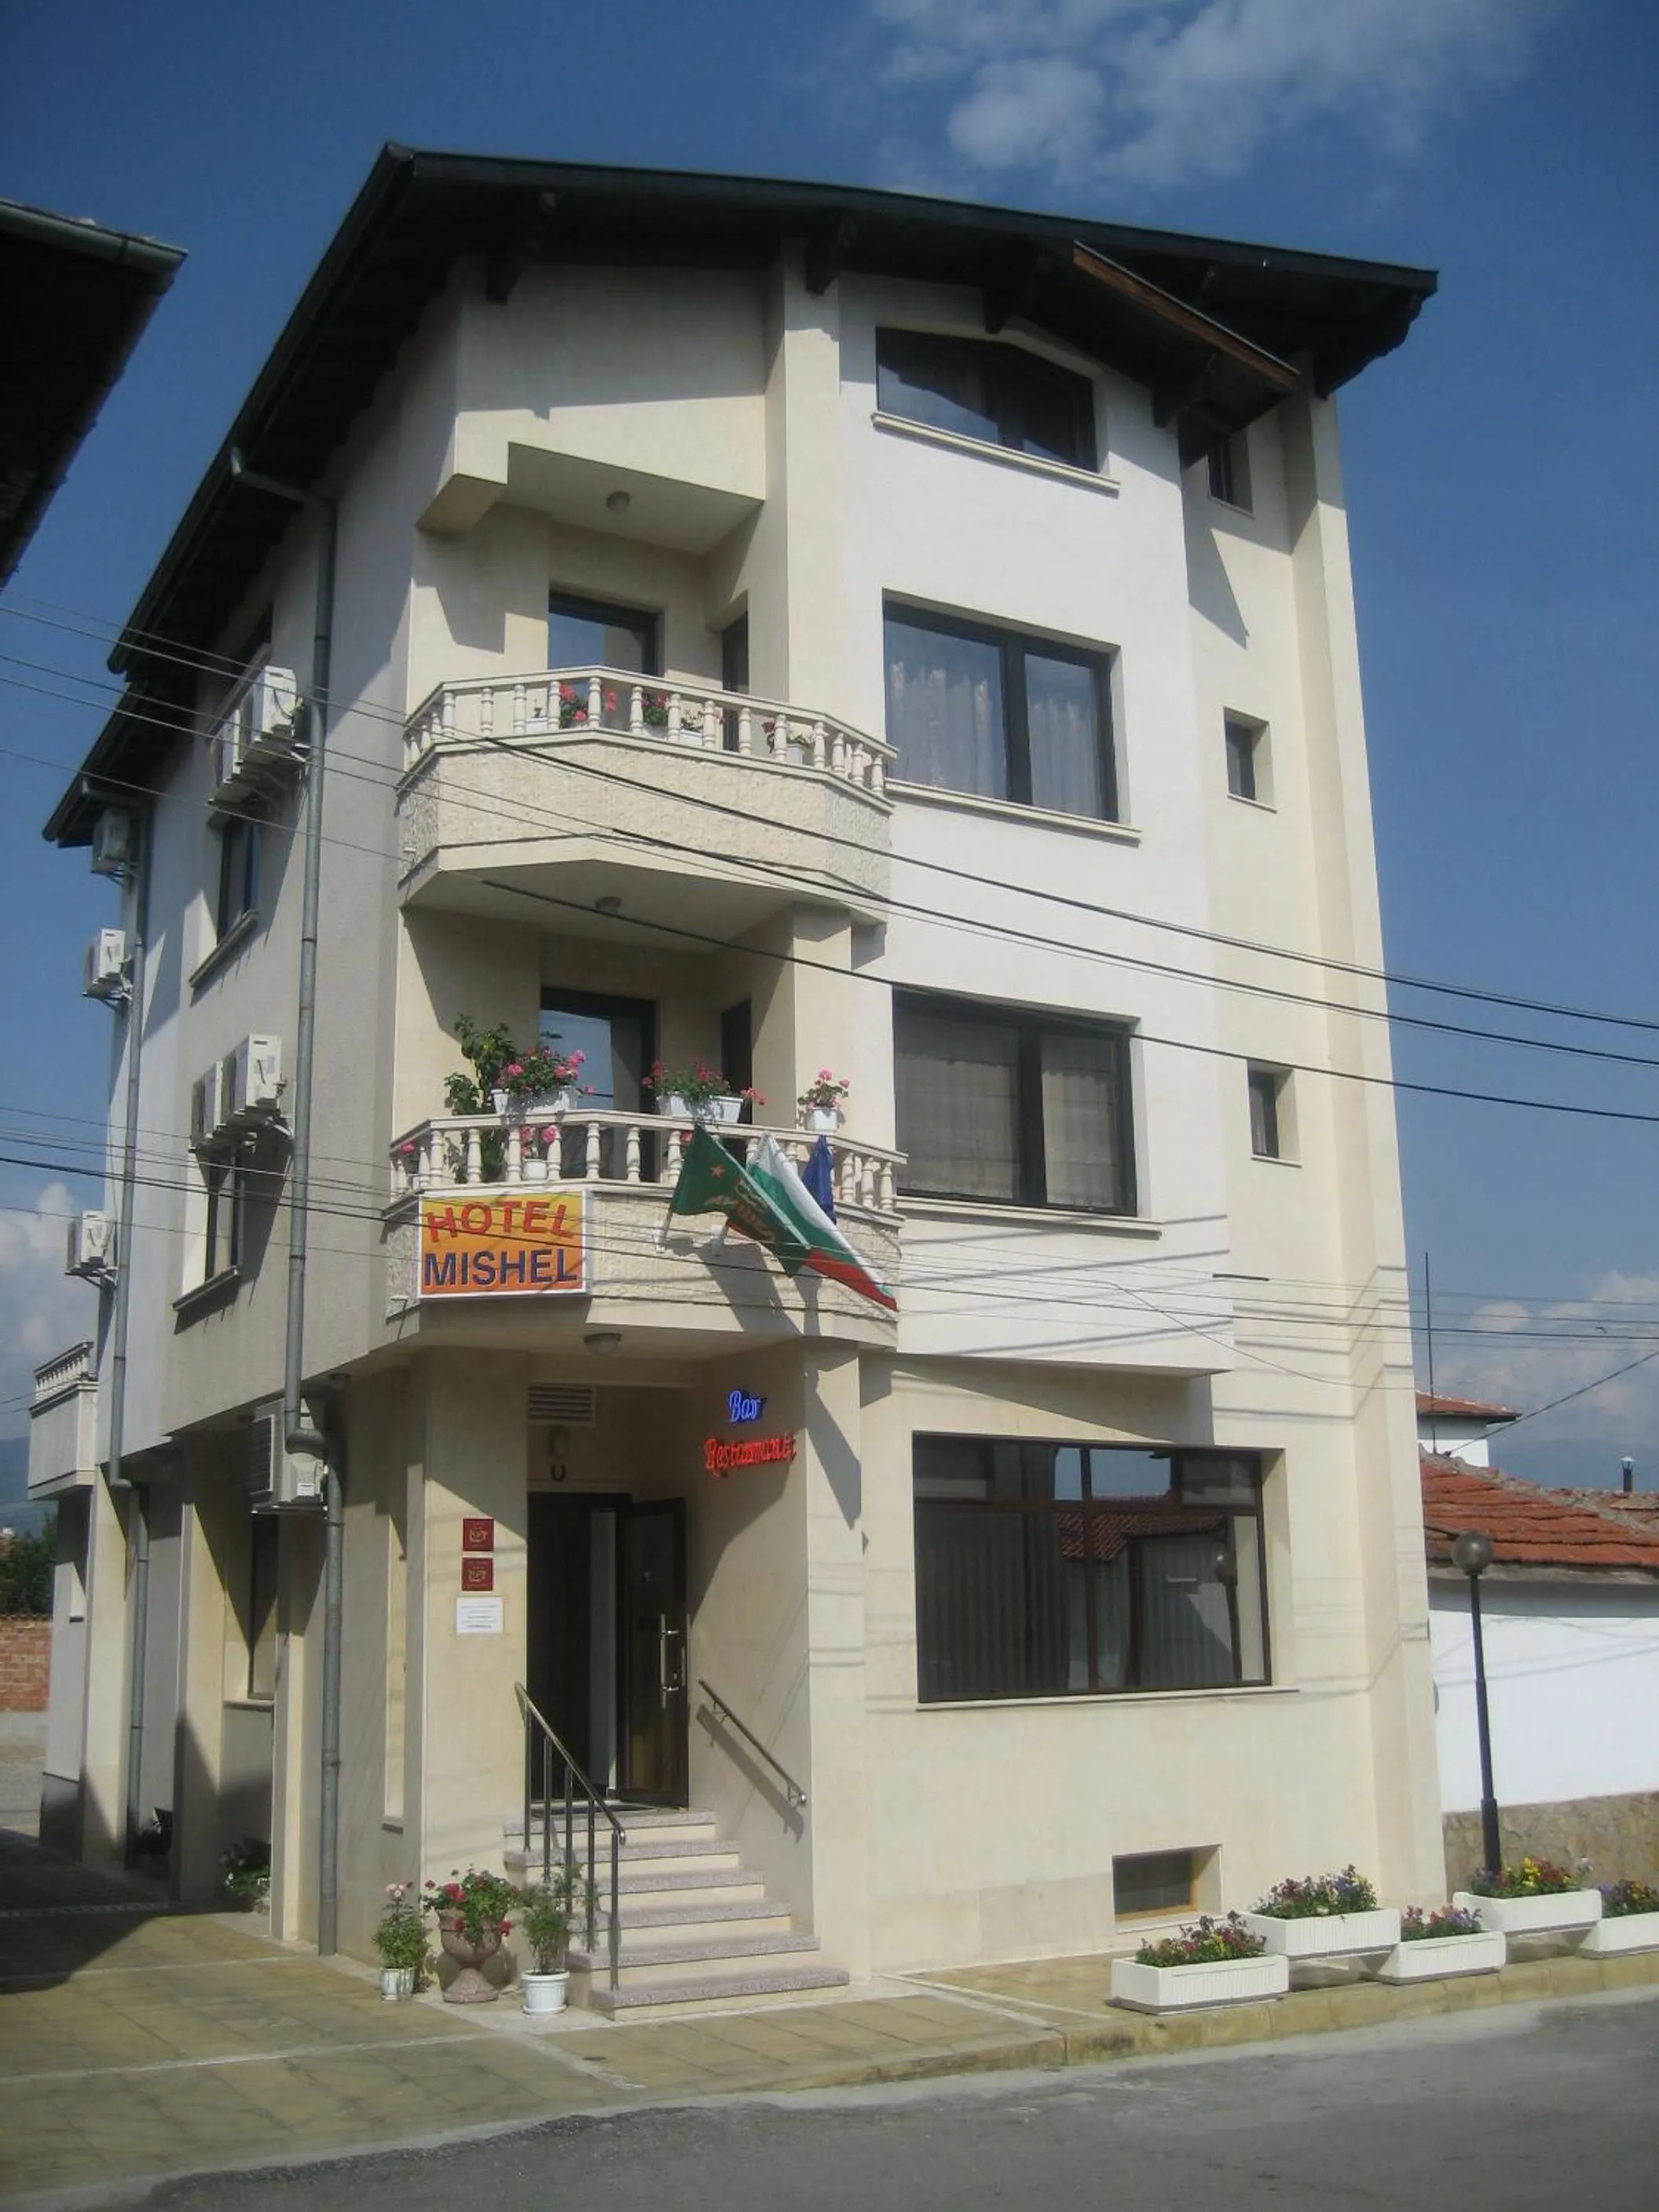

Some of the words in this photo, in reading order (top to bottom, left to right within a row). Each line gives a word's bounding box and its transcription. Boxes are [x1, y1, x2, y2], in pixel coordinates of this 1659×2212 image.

[427, 1201, 573, 1243] HOTEL
[424, 1249, 577, 1286] MISHEL
[728, 1390, 763, 1423] Bar
